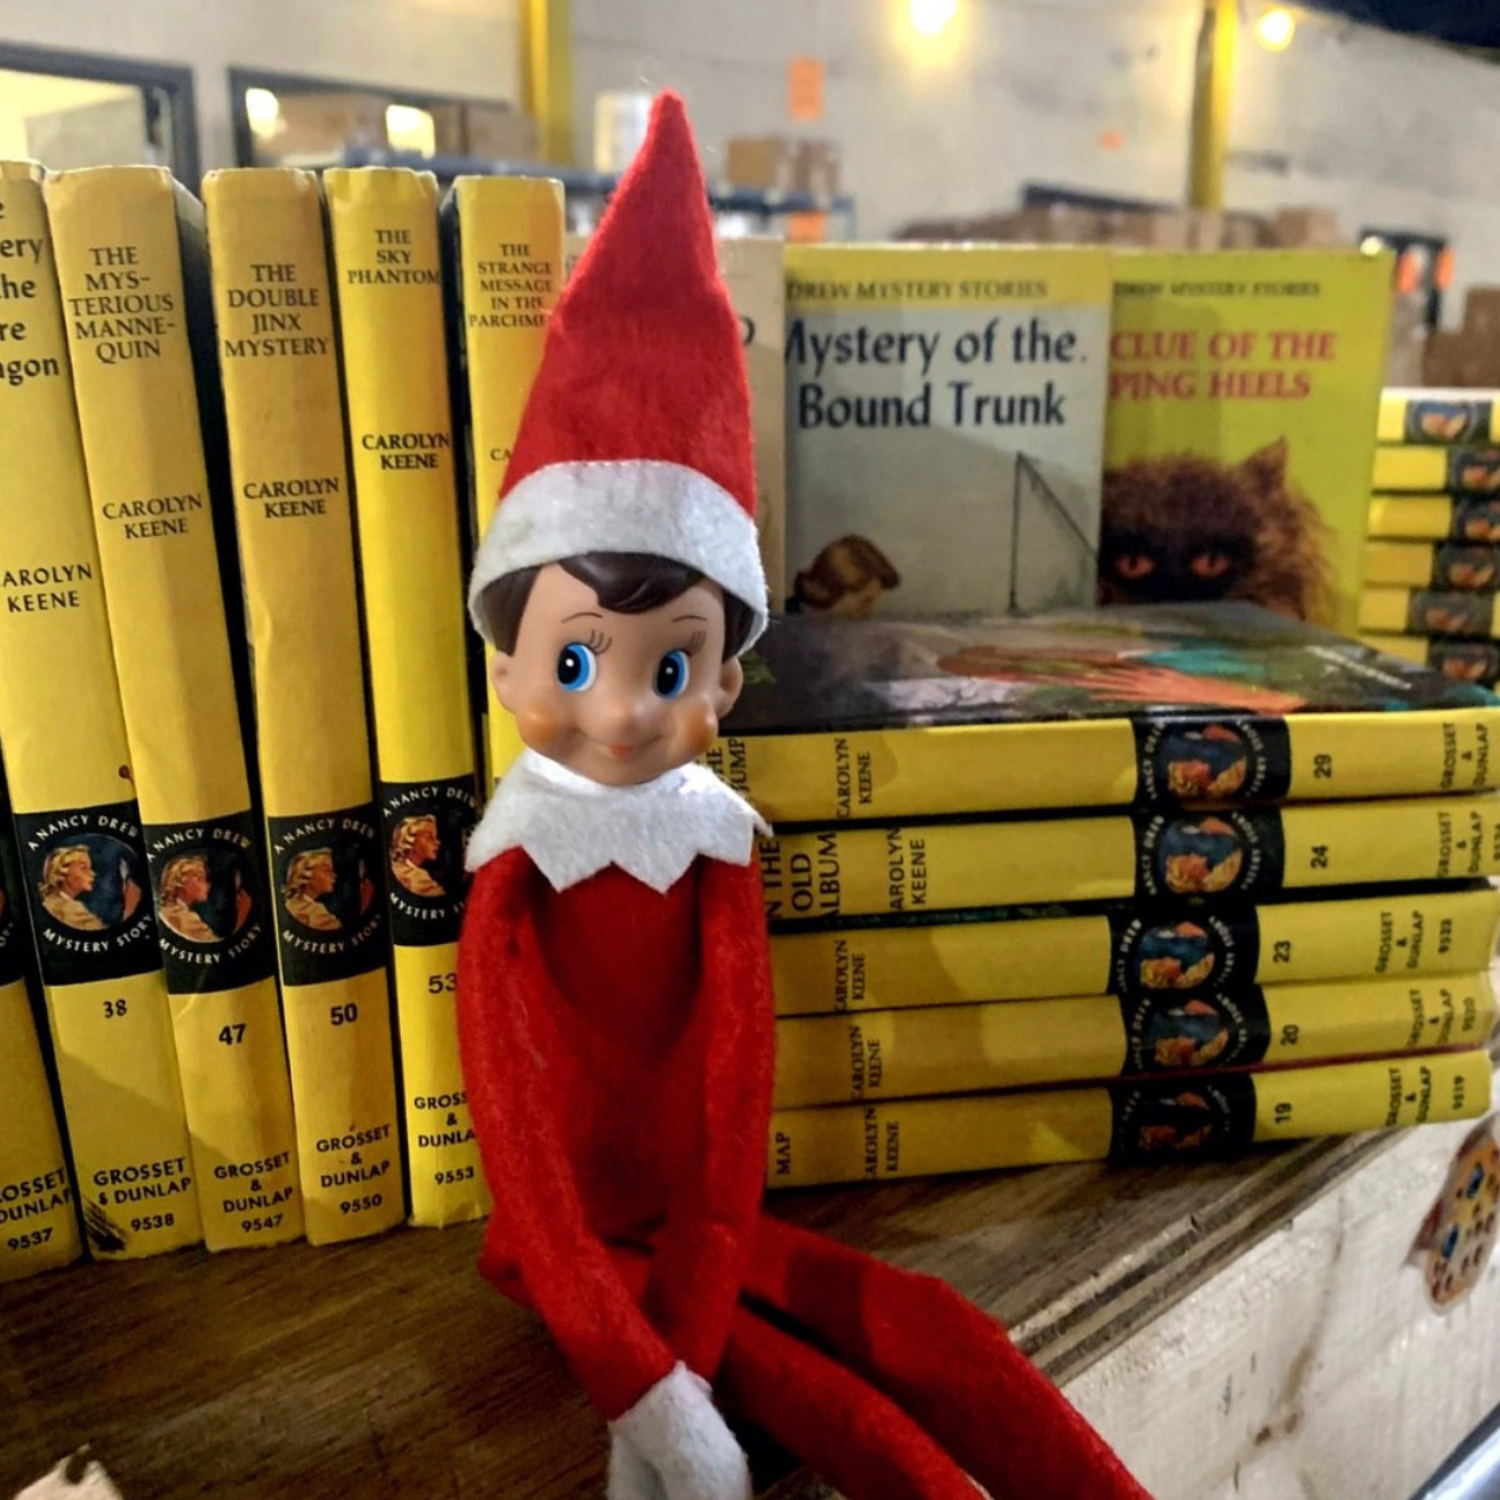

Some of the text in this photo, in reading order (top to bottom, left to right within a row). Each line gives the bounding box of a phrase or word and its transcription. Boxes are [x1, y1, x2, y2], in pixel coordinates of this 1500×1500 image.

[375, 229, 412, 245] THE
[89, 246, 139, 266] THE
[377, 249, 412, 265] SKY
[499, 244, 531, 258] THE
[251, 264, 297, 283] THE
[347, 269, 440, 286] PHANTOM
[478, 261, 553, 275] STRANGE
[85, 270, 150, 291] MYS-
[480, 278, 554, 293] MESSAGE
[787, 280, 1048, 300] DREW MYSTERY STORIES
[68, 294, 174, 317] TERIOUS
[227, 288, 320, 309] DOUBLE
[491, 296, 511, 310] IN
[74, 317, 176, 339] MANNE-
[252, 313, 301, 334] JINX
[96, 340, 160, 363] QUIN
[225, 337, 330, 358] MYSTERY
[954, 317, 1000, 364] of
[1012, 320, 1078, 363] the
[1110, 330, 1337, 362] CLUE OF THE
[1110, 370, 1312, 401] PING HEELS
[799, 380, 1067, 430] Bound Trunk
[362, 432, 452, 451] CAROLYN
[380, 452, 439, 471] KEENE
[243, 476, 340, 501] CAROLYN
[102, 493, 203, 521] CAROLYN
[264, 498, 327, 520] KEENE
[124, 518, 189, 541] KEENE
[0, 562, 92, 587] AROLYN
[7, 590, 80, 615] KEENE
[836, 737, 848, 818] CAROLYN
[1313, 753, 1333, 779] 29
[857, 751, 872, 805] KEENE
[35, 814, 89, 841] NANCY
[98, 815, 139, 838] DREW
[153, 828, 204, 850] NANCY
[212, 828, 254, 849] DREW
[283, 818, 336, 844] NANCY
[761, 837, 783, 891] THE
[1310, 844, 1330, 870] 24
[888, 827, 904, 911] AROLYN
[910, 838, 926, 905] KEENE
[790, 850, 812, 913] OLD
[43, 914, 152, 953] MYSTERY STORY
[158, 923, 263, 964] MYSTERY STORY
[282, 929, 345, 954] MYSTERY
[1273, 940, 1291, 964] 23
[428, 973, 456, 994] 53
[852, 953, 866, 1001] KEENE
[103, 1000, 128, 1019] 38
[330, 1003, 359, 1026] 50
[218, 1024, 247, 1046] 47
[1280, 1024, 1299, 1047] 20
[414, 1093, 469, 1111] GROSS
[1275, 1102, 1292, 1125] 19
[446, 1112, 458, 1127] &
[316, 1124, 391, 1153] GROSSET
[418, 1130, 476, 1149] DUNLA
[886, 1121, 899, 1171] KEENE
[350, 1151, 362, 1165] &
[775, 1131, 791, 1176] MAP
[94, 1156, 186, 1186] GROSSET
[214, 1151, 291, 1180] GROSSET
[320, 1160, 391, 1188] DUNLAP
[434, 1166, 475, 1186] 9553
[0, 1167, 66, 1202] OSSET
[115, 1177, 192, 1204] DUNLAP
[251, 1178, 262, 1192] &
[222, 1186, 294, 1213] DUNLAP
[340, 1193, 383, 1215] 9550
[130, 1213, 174, 1231] 9538
[241, 1214, 284, 1233] 9547
[8, 1227, 54, 1250] 9537
